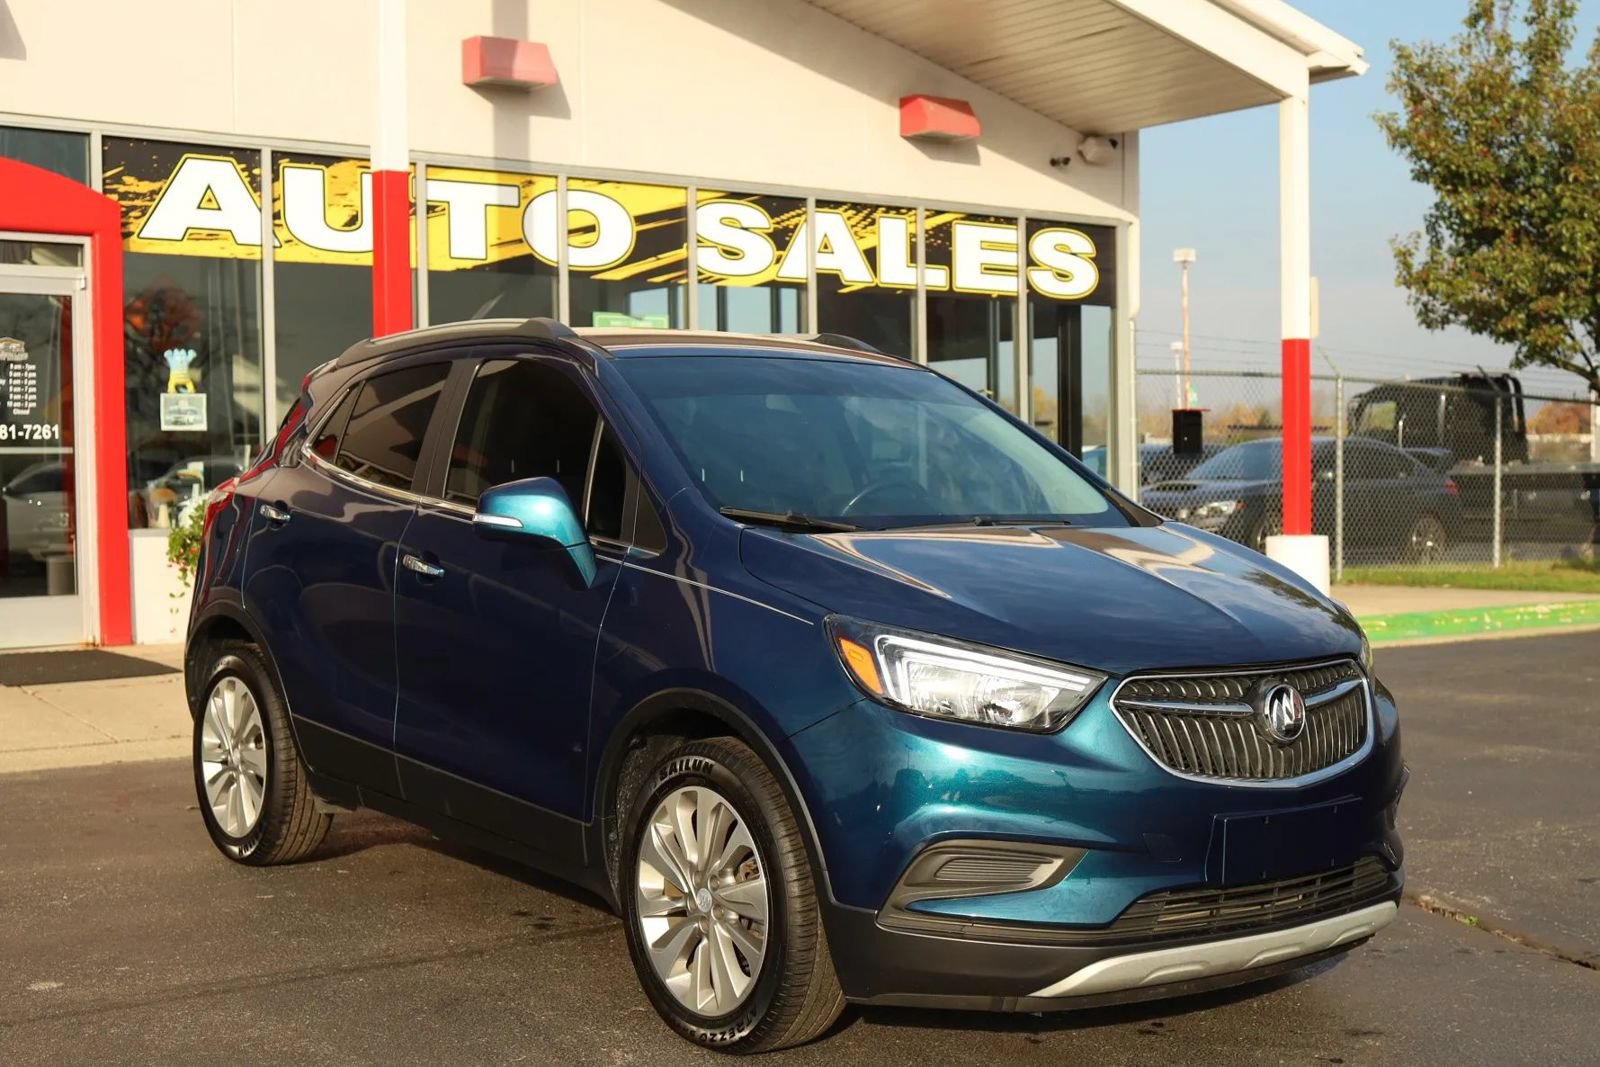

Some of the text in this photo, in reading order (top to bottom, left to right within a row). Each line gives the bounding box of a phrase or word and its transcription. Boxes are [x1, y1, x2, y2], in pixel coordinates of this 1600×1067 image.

[137, 153, 1099, 299] AUTO SALES
[0, 424, 60, 440] 81-7261
[659, 758, 714, 781] SAILUN
